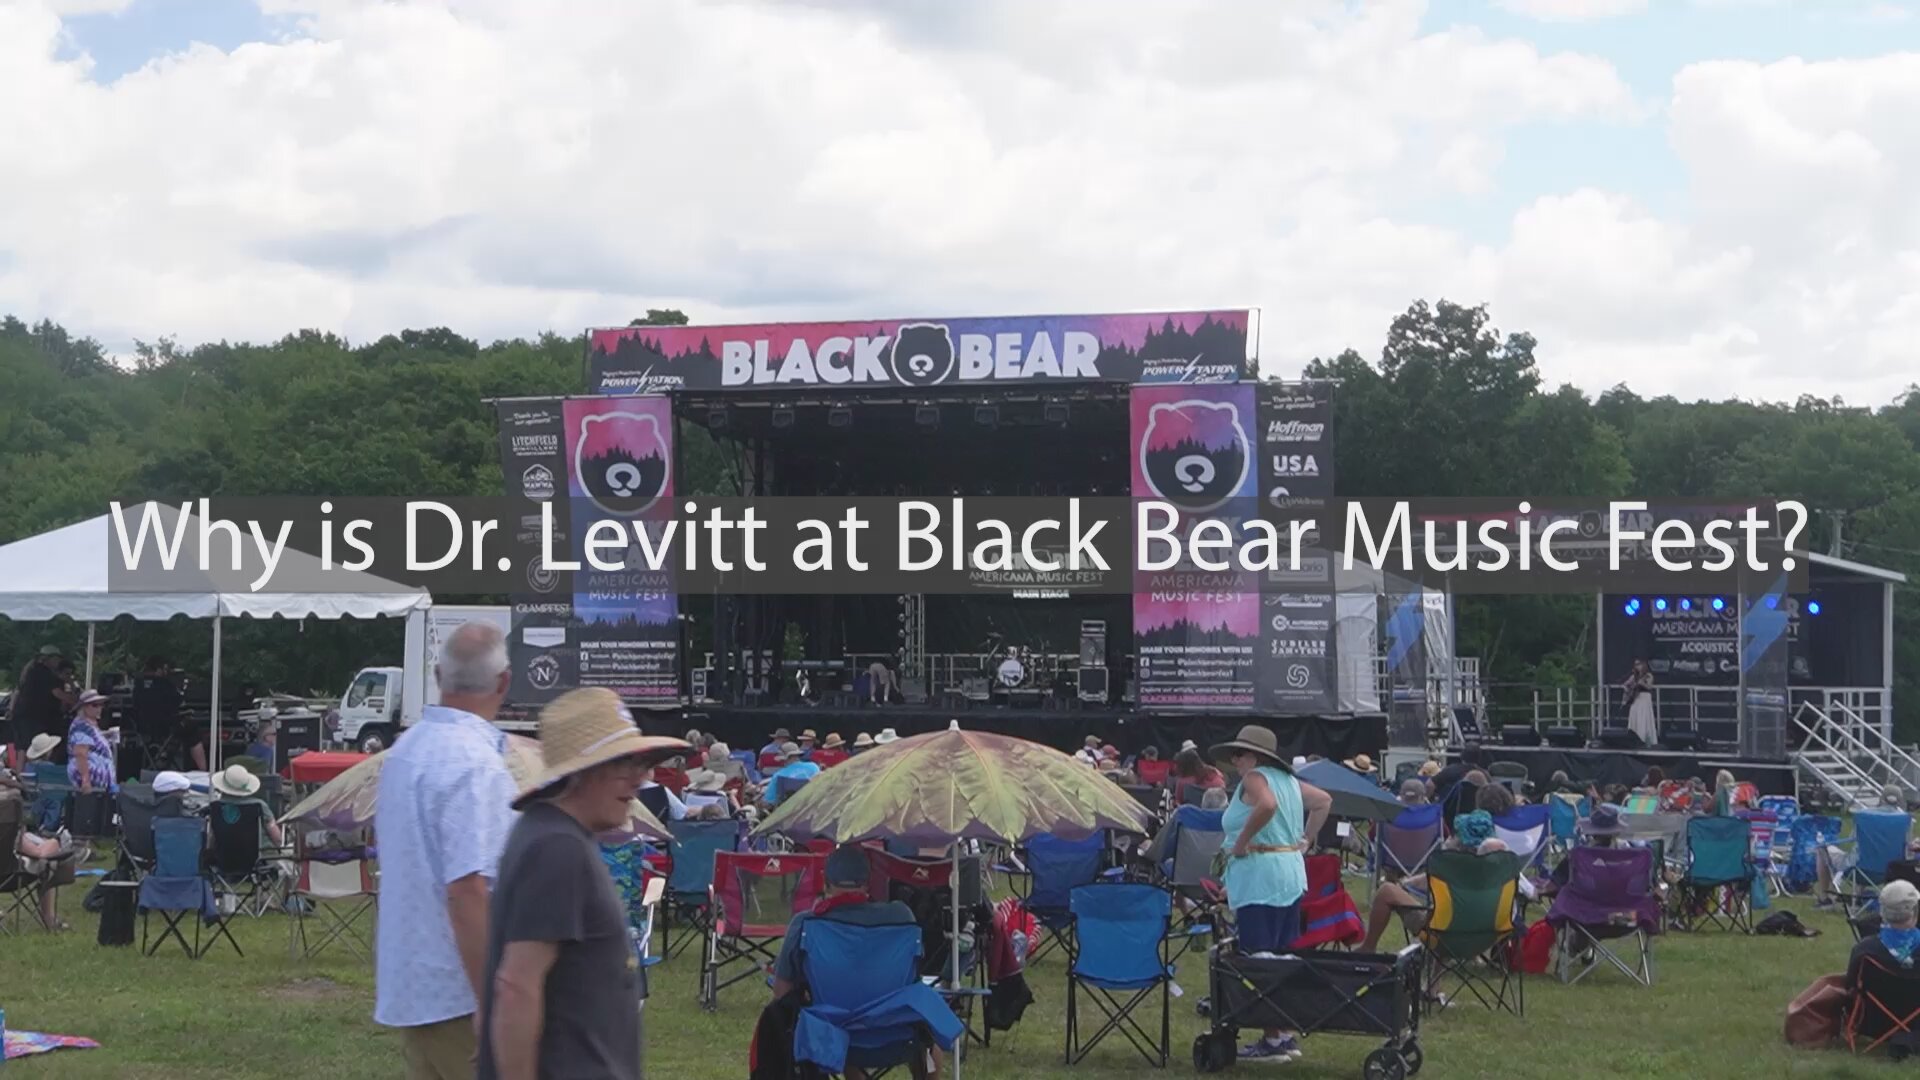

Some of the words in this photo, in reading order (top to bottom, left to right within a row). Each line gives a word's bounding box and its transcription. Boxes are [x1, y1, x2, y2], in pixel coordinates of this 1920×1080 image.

[721, 336, 891, 386] BLACK
[958, 331, 1100, 380] BEAR
[1268, 420, 1325, 435] Hoffman
[512, 434, 558, 447] LITCHFIELD
[1273, 454, 1320, 473] USA
[588, 574, 669, 587] AMERICANA
[969, 571, 1034, 583] AMERICANA
[1036, 571, 1073, 583] MUSIC
[1076, 571, 1105, 583] FEST
[1150, 574, 1245, 588] AMERICANA
[589, 588, 631, 601] MUSIC
[635, 588, 668, 601] FEST
[1151, 590, 1201, 603] MUSIC
[1206, 590, 1242, 604] FEST
[1652, 621, 1723, 636] AMERICANA
[1680, 641, 1735, 654] ACOUSTIC
